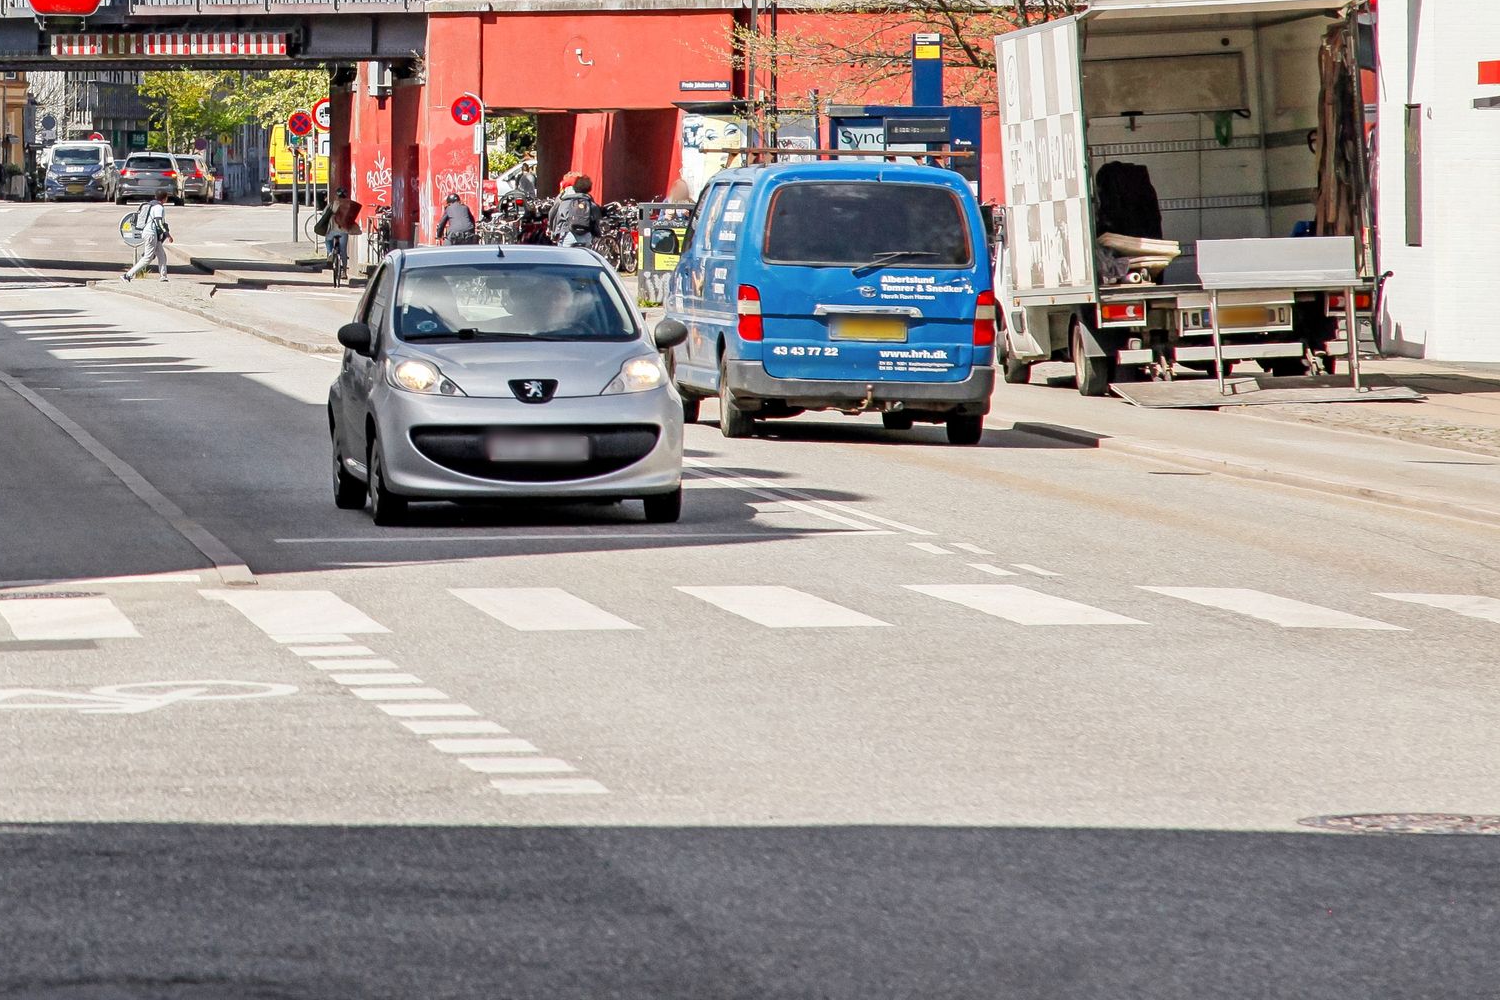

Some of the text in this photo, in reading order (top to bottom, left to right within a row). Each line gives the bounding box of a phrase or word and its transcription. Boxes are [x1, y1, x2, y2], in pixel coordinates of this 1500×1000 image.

[881, 275, 935, 284] Albertslund
[916, 284, 924, 292] &
[925, 284, 963, 293] Snedker
[773, 346, 838, 356] 43 43 77 22
[879, 350, 947, 359] www.hrh.dk
